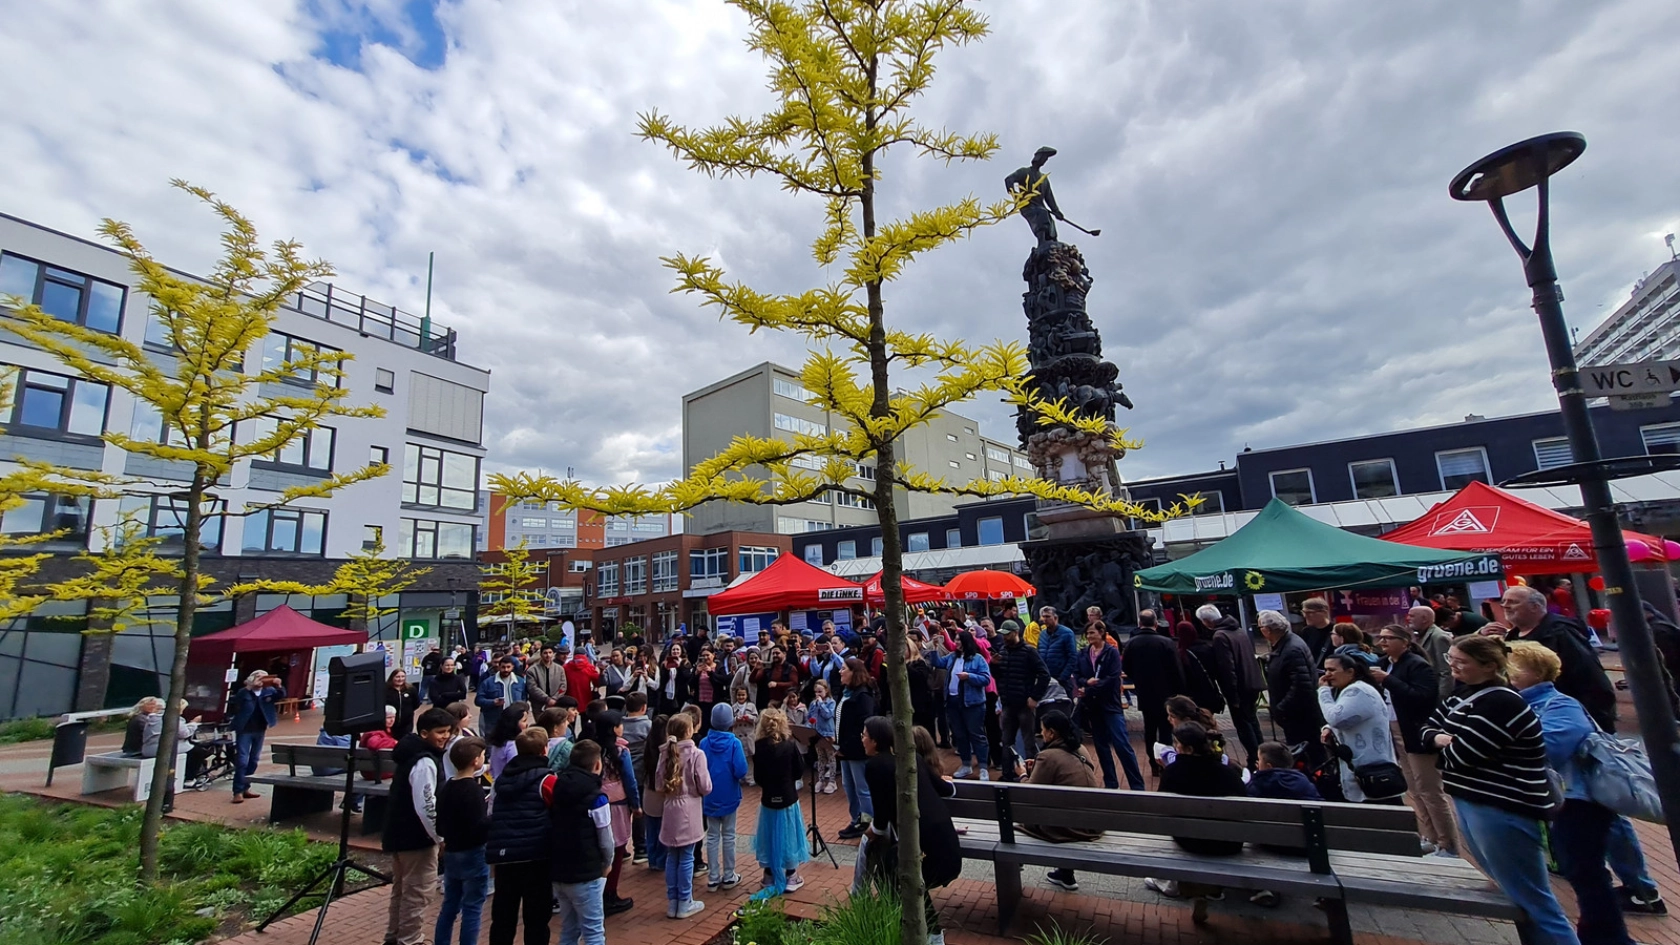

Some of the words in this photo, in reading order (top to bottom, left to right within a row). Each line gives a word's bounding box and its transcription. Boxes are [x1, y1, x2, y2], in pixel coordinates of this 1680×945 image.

[1591, 370, 1634, 390] WC
[1417, 556, 1498, 584] gruene.de
[821, 591, 834, 599] DIE
[409, 625, 424, 638] D
